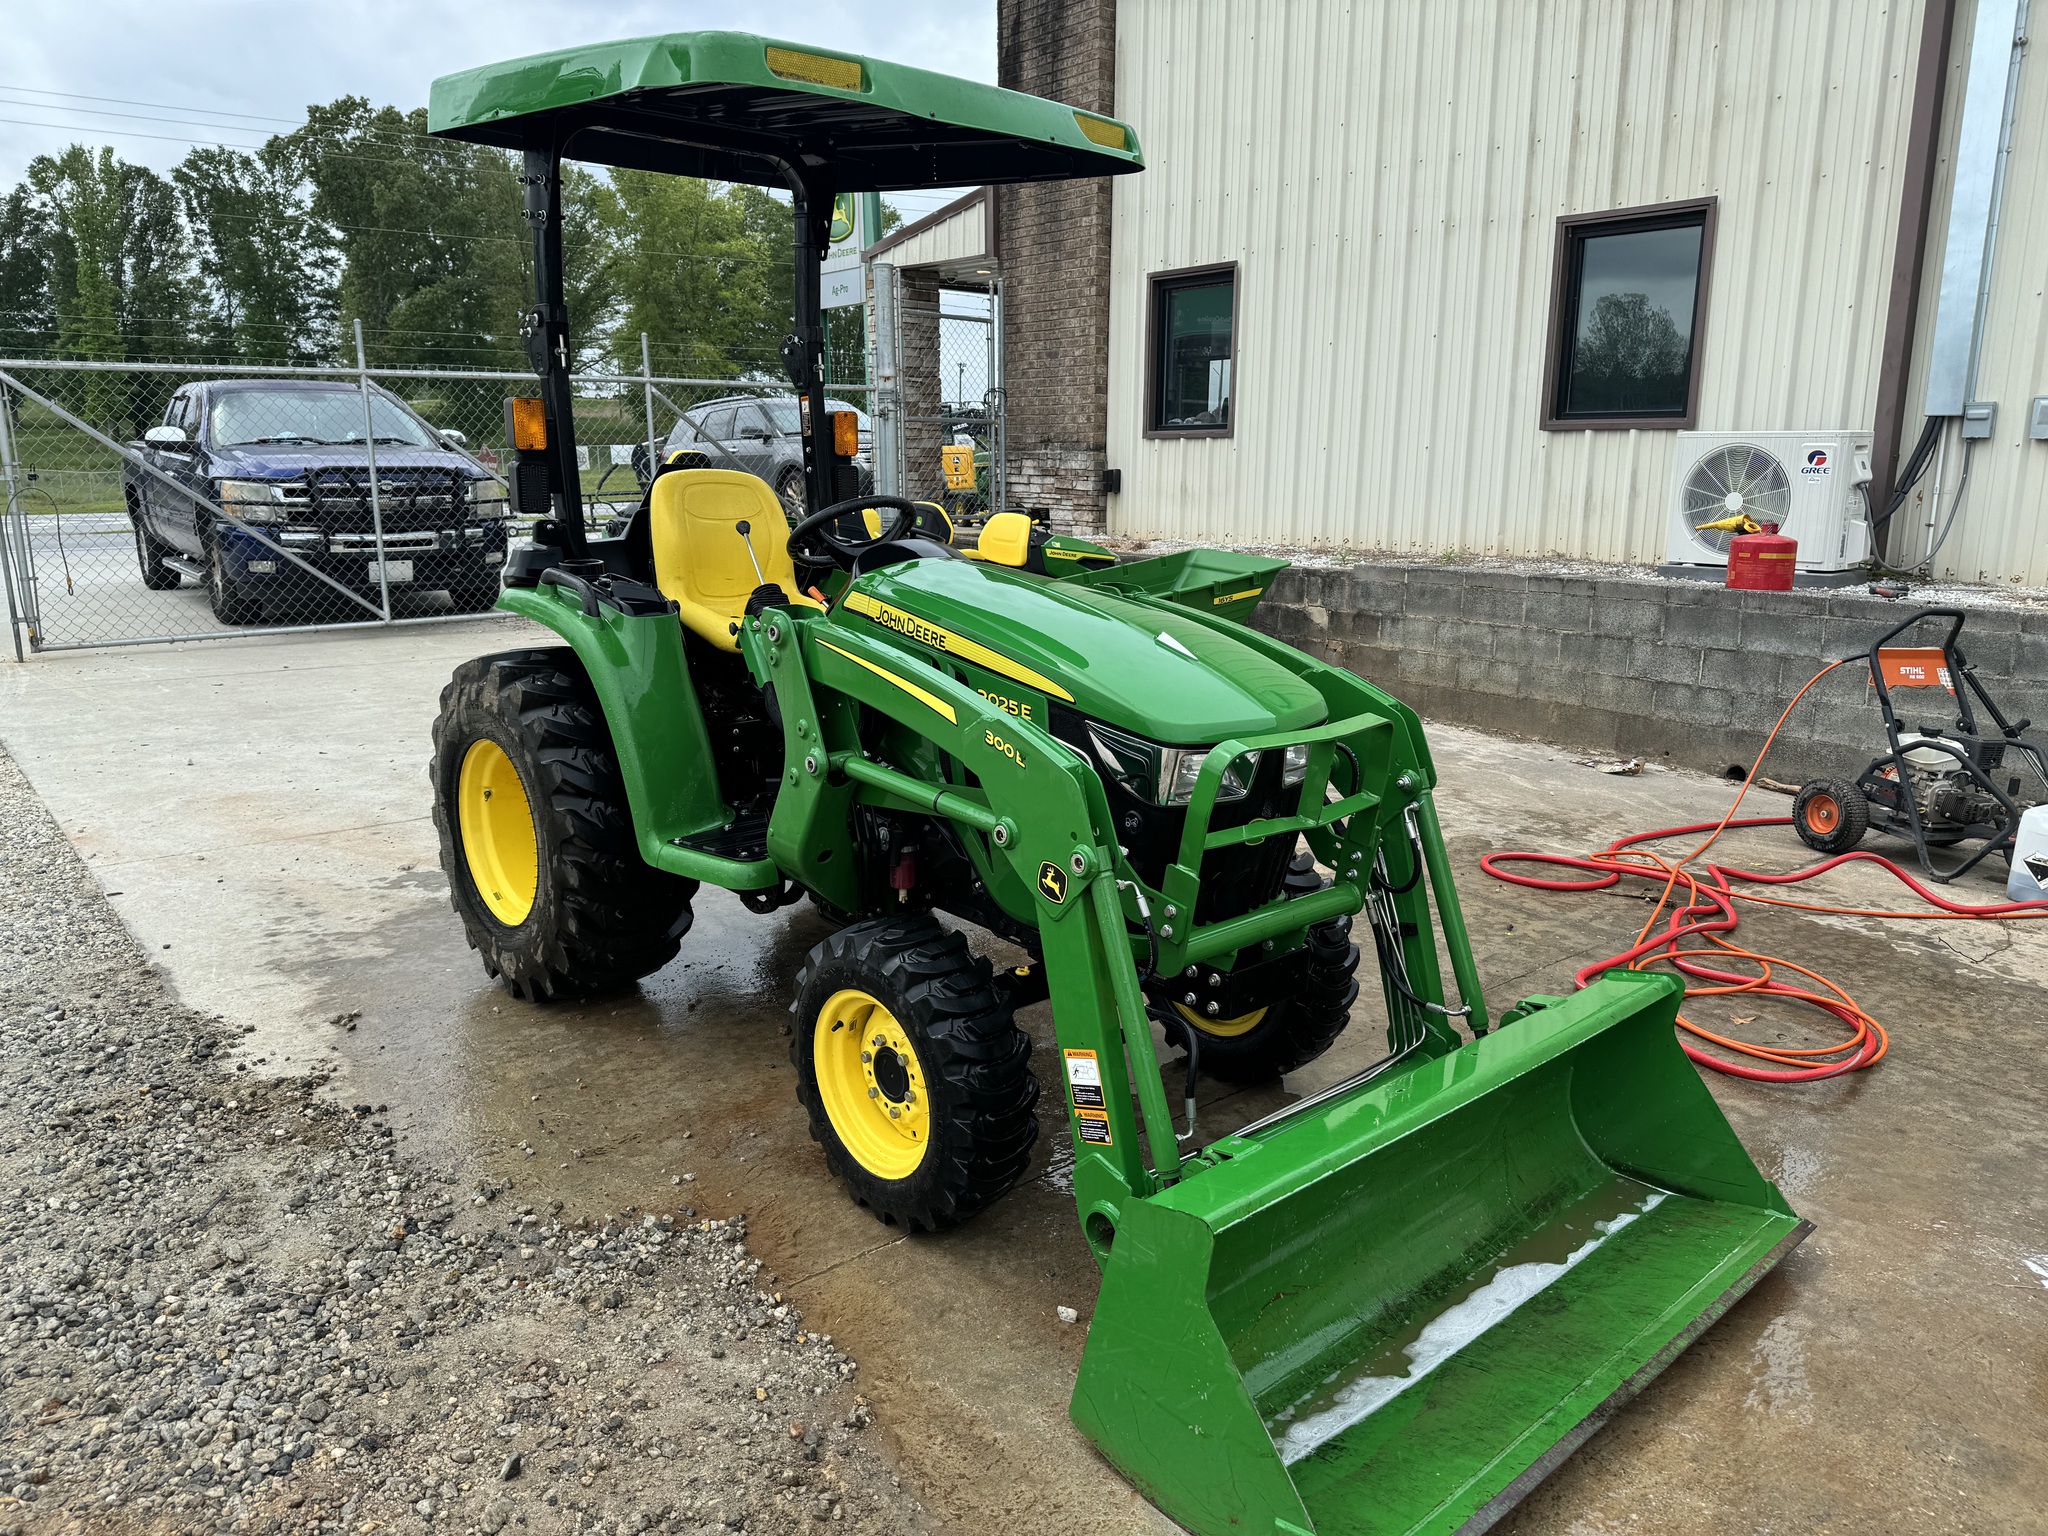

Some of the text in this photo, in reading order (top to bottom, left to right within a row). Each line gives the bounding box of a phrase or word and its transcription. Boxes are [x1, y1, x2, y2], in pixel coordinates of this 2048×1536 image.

[838, 246, 857, 258] DEERE
[832, 284, 848, 296] Ag-Pro
[1801, 467, 1831, 475] GREE
[875, 605, 947, 649] JOHN DEERE
